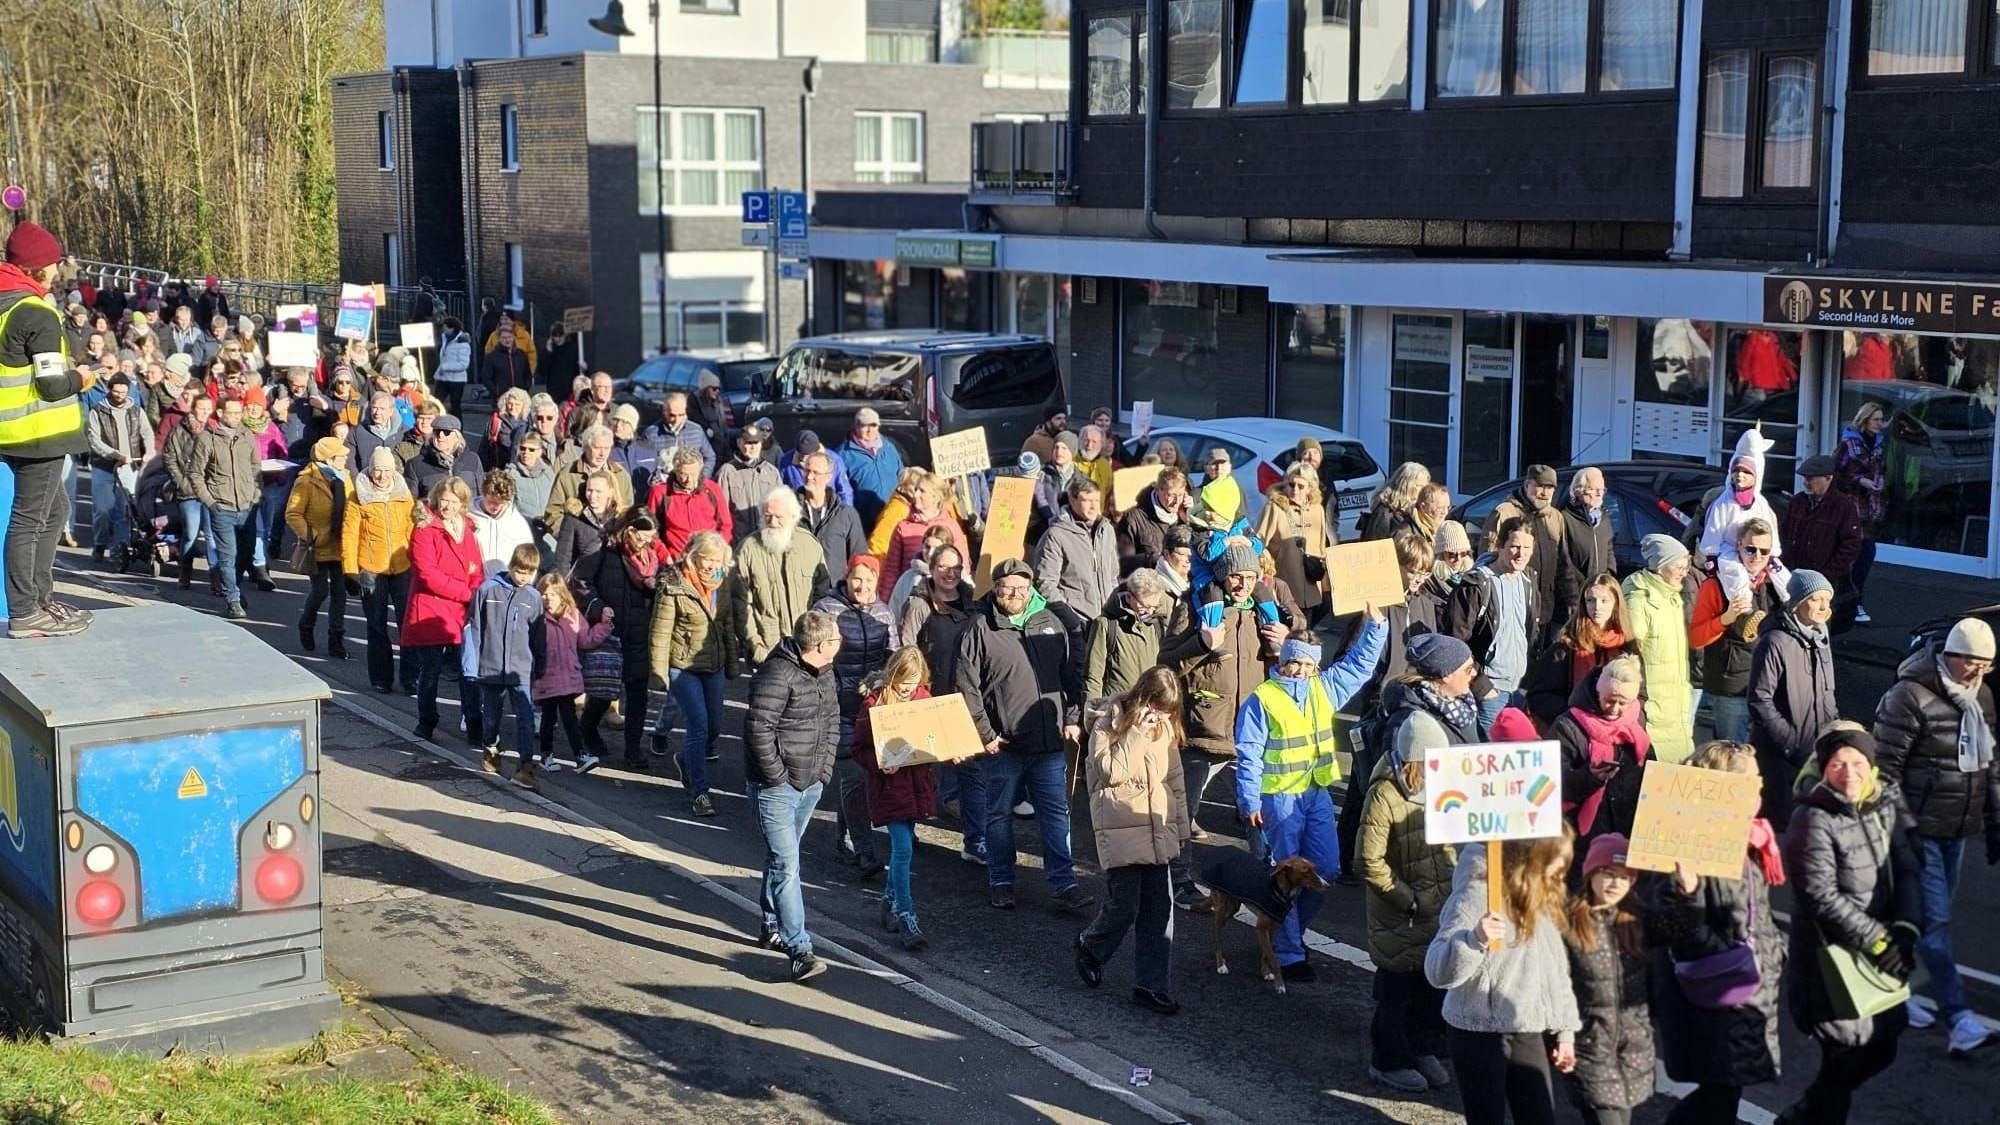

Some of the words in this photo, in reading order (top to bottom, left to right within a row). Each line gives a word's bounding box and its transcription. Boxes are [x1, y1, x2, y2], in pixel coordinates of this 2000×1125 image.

[748, 195, 763, 219] P
[783, 195, 796, 214] P
[896, 242, 957, 259] PROVINZIAL
[1819, 288, 1953, 314] SKYLINE
[1819, 311, 1852, 322] Second
[1854, 312, 1879, 324] Hand
[1880, 313, 1888, 324] &
[1890, 314, 1915, 326] More
[1443, 750, 1543, 775] ÖSRATH
[1481, 780, 1525, 798] BLIBT
[1669, 772, 1737, 804] NAZIS
